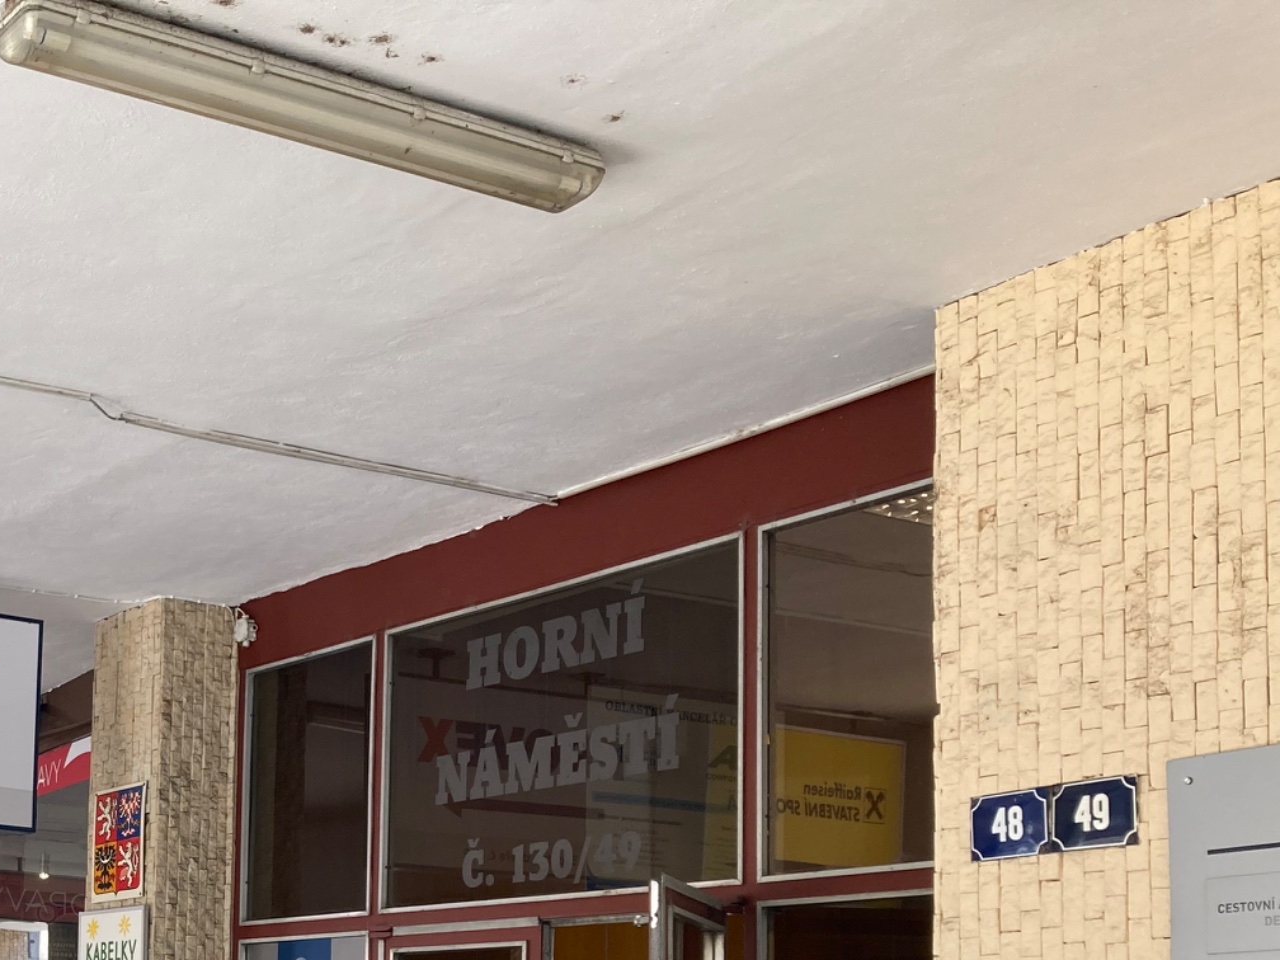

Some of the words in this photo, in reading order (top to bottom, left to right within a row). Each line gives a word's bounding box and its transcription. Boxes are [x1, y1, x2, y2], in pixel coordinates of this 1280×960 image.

[466, 579, 646, 690] HORNÍ
[435, 692, 680, 805] NÁMĚSTÍ
[991, 805, 1023, 842] 48
[1074, 793, 1110, 831] 49
[462, 838, 495, 889] Č.
[511, 831, 642, 885] 130/49
[1217, 896, 1275, 914] CESTOVNÍ
